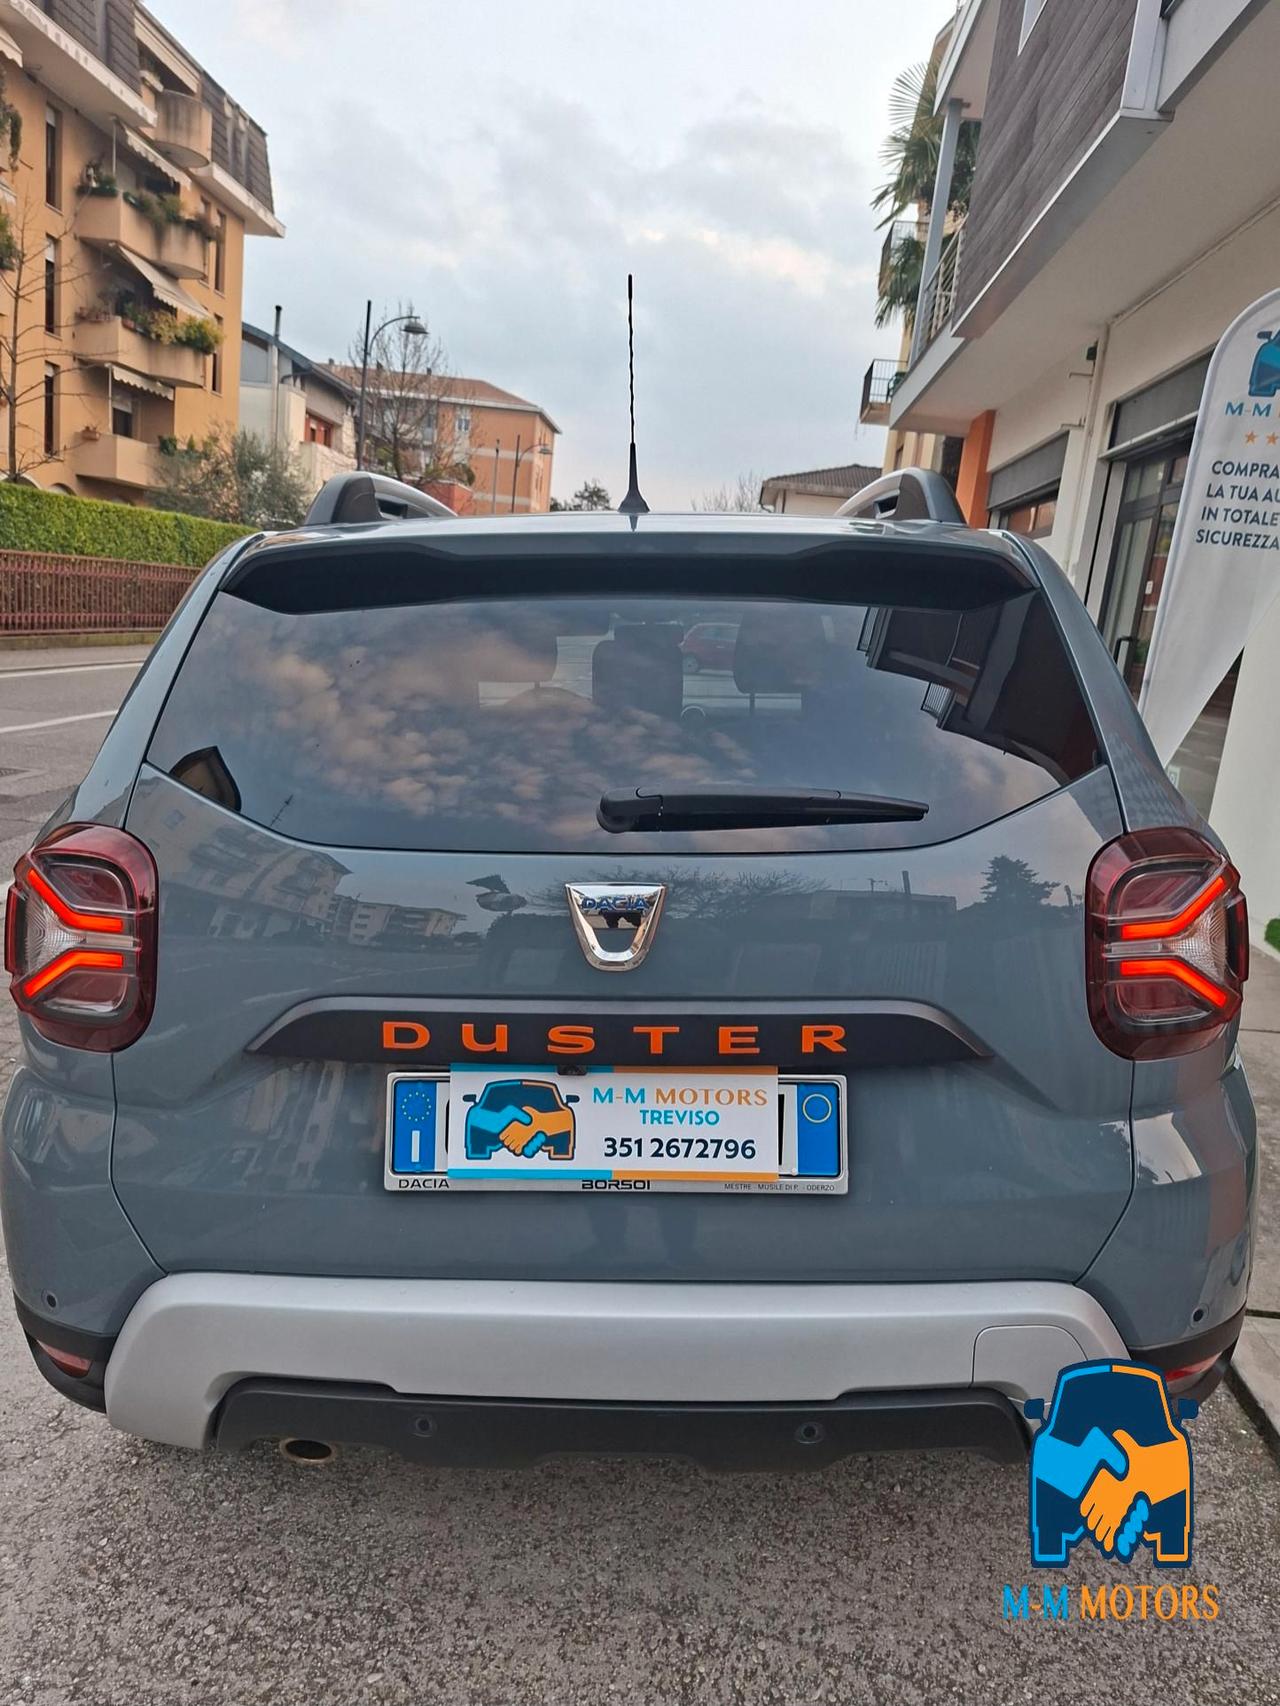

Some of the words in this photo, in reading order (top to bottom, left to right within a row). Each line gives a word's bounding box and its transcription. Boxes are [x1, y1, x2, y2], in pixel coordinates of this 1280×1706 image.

[1211, 460, 1280, 480] COMPRA
[1206, 483, 1225, 499] LA
[1230, 485, 1259, 502] TUA
[1201, 506, 1219, 522] IN
[1223, 508, 1280, 527] TOTALE
[1195, 529, 1280, 550] SICUREZZA
[581, 895, 650, 910] DACIA
[382, 1021, 847, 1055] DUSTER
[593, 1087, 646, 1105] M-M
[655, 1087, 768, 1106] MOTORS
[639, 1109, 721, 1126] TREVISO
[603, 1137, 643, 1158] 351
[650, 1138, 757, 1160] 2672796
[398, 1179, 450, 1189] DACIA
[581, 1179, 651, 1190] BORSOI
